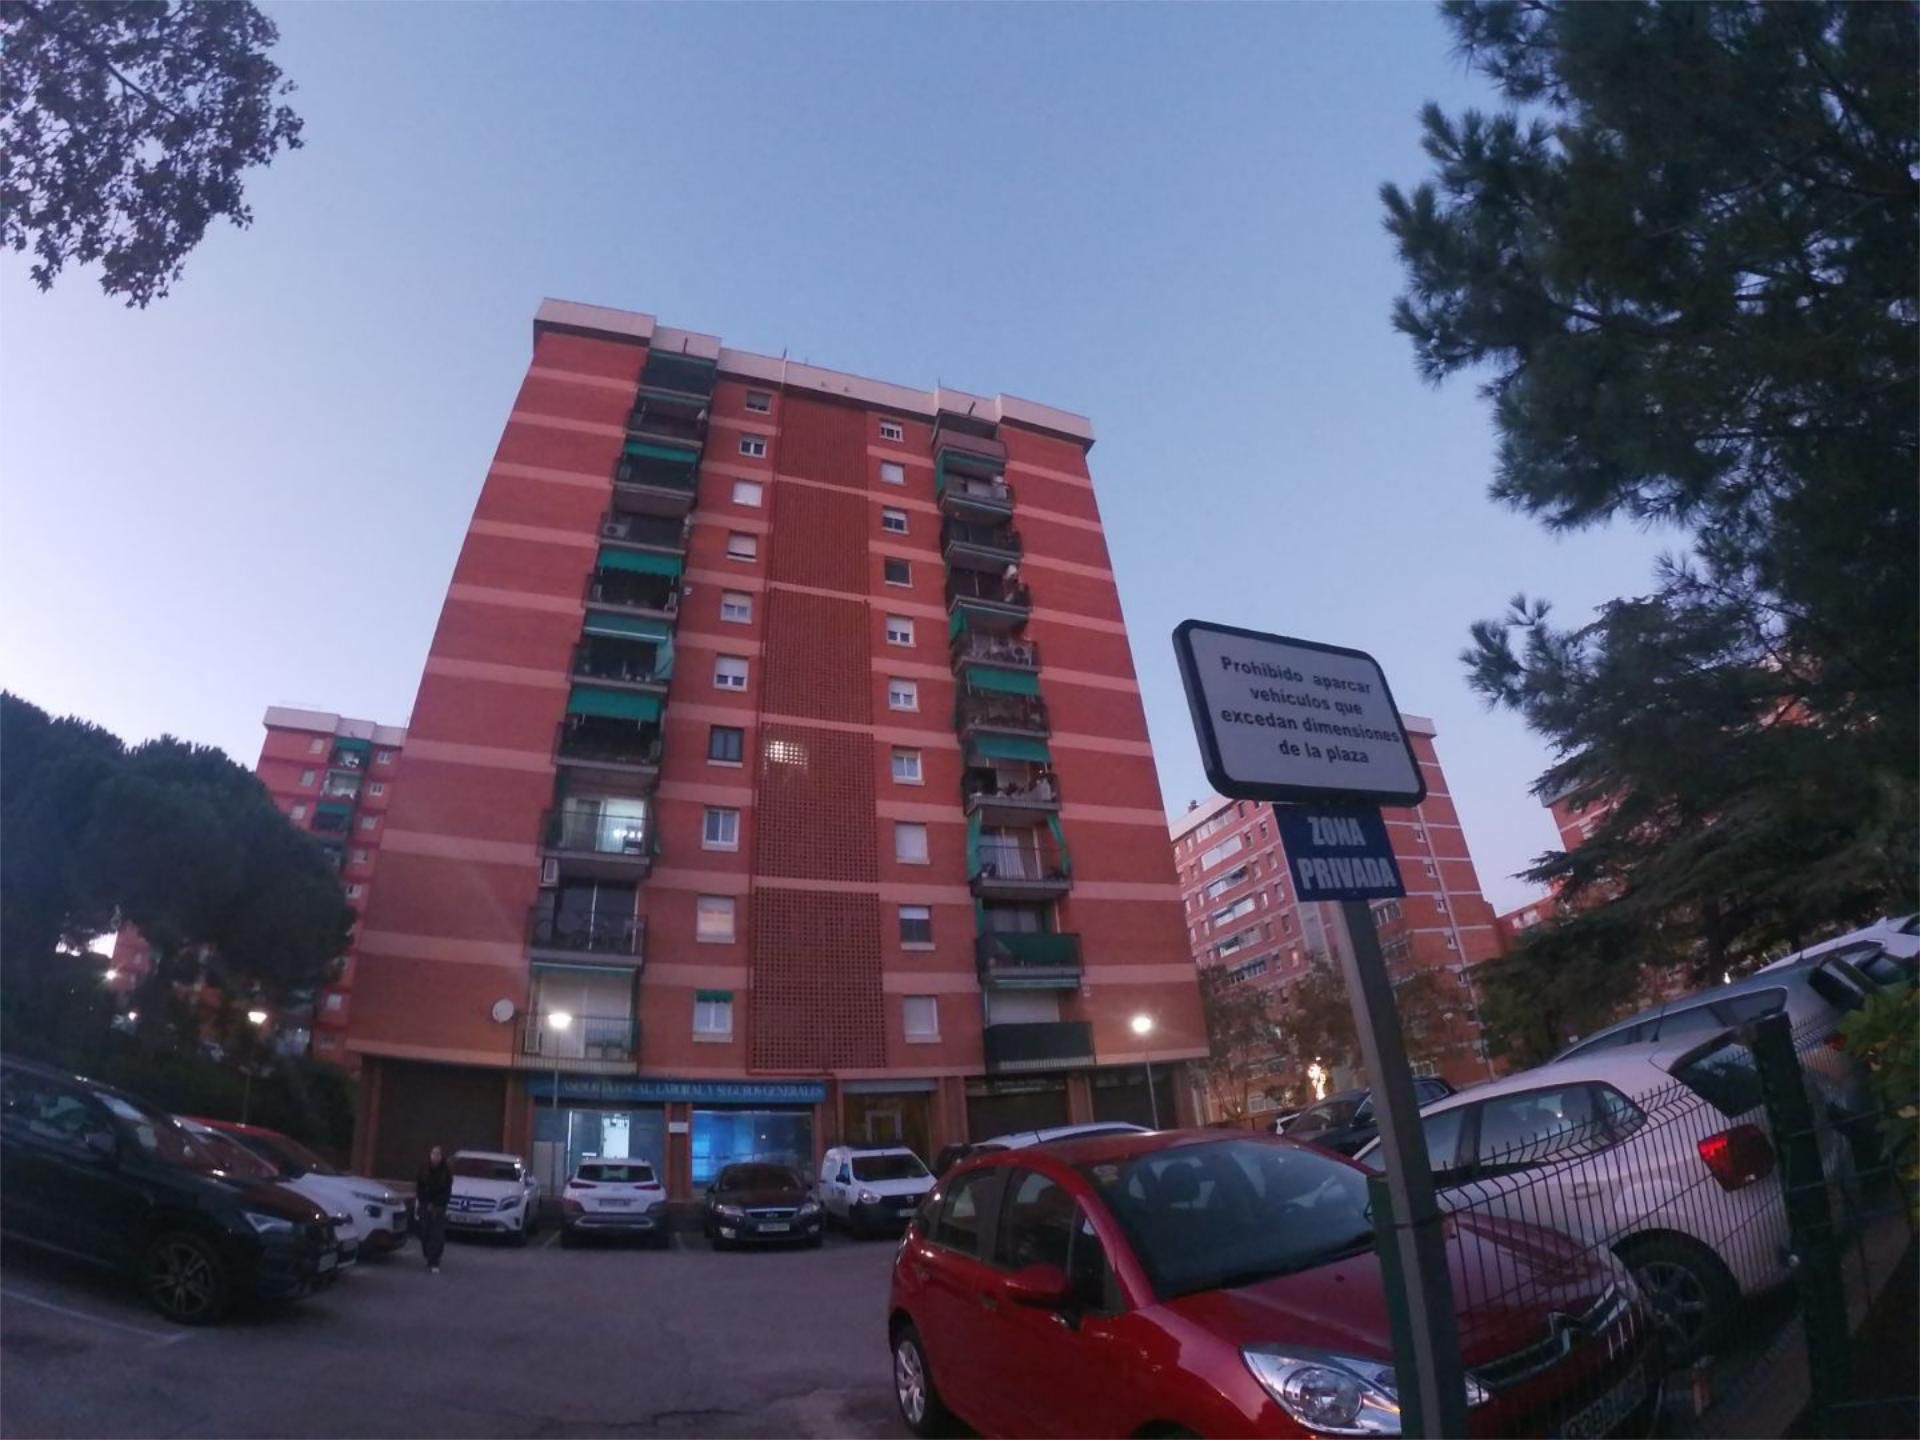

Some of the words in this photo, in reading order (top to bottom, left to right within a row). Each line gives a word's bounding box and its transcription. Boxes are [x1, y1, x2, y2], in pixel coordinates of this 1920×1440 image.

[1220, 656, 1303, 682] Prohibido
[1313, 674, 1371, 694] aparcar
[1335, 701, 1363, 716] que
[1221, 709, 1298, 730] excedan
[1302, 718, 1399, 743] dimensiones
[1279, 740, 1301, 756] de
[1305, 742, 1322, 758] la
[1326, 746, 1369, 763] plaza
[1307, 816, 1366, 846] ZONA
[1297, 857, 1397, 890] PRIVADA
